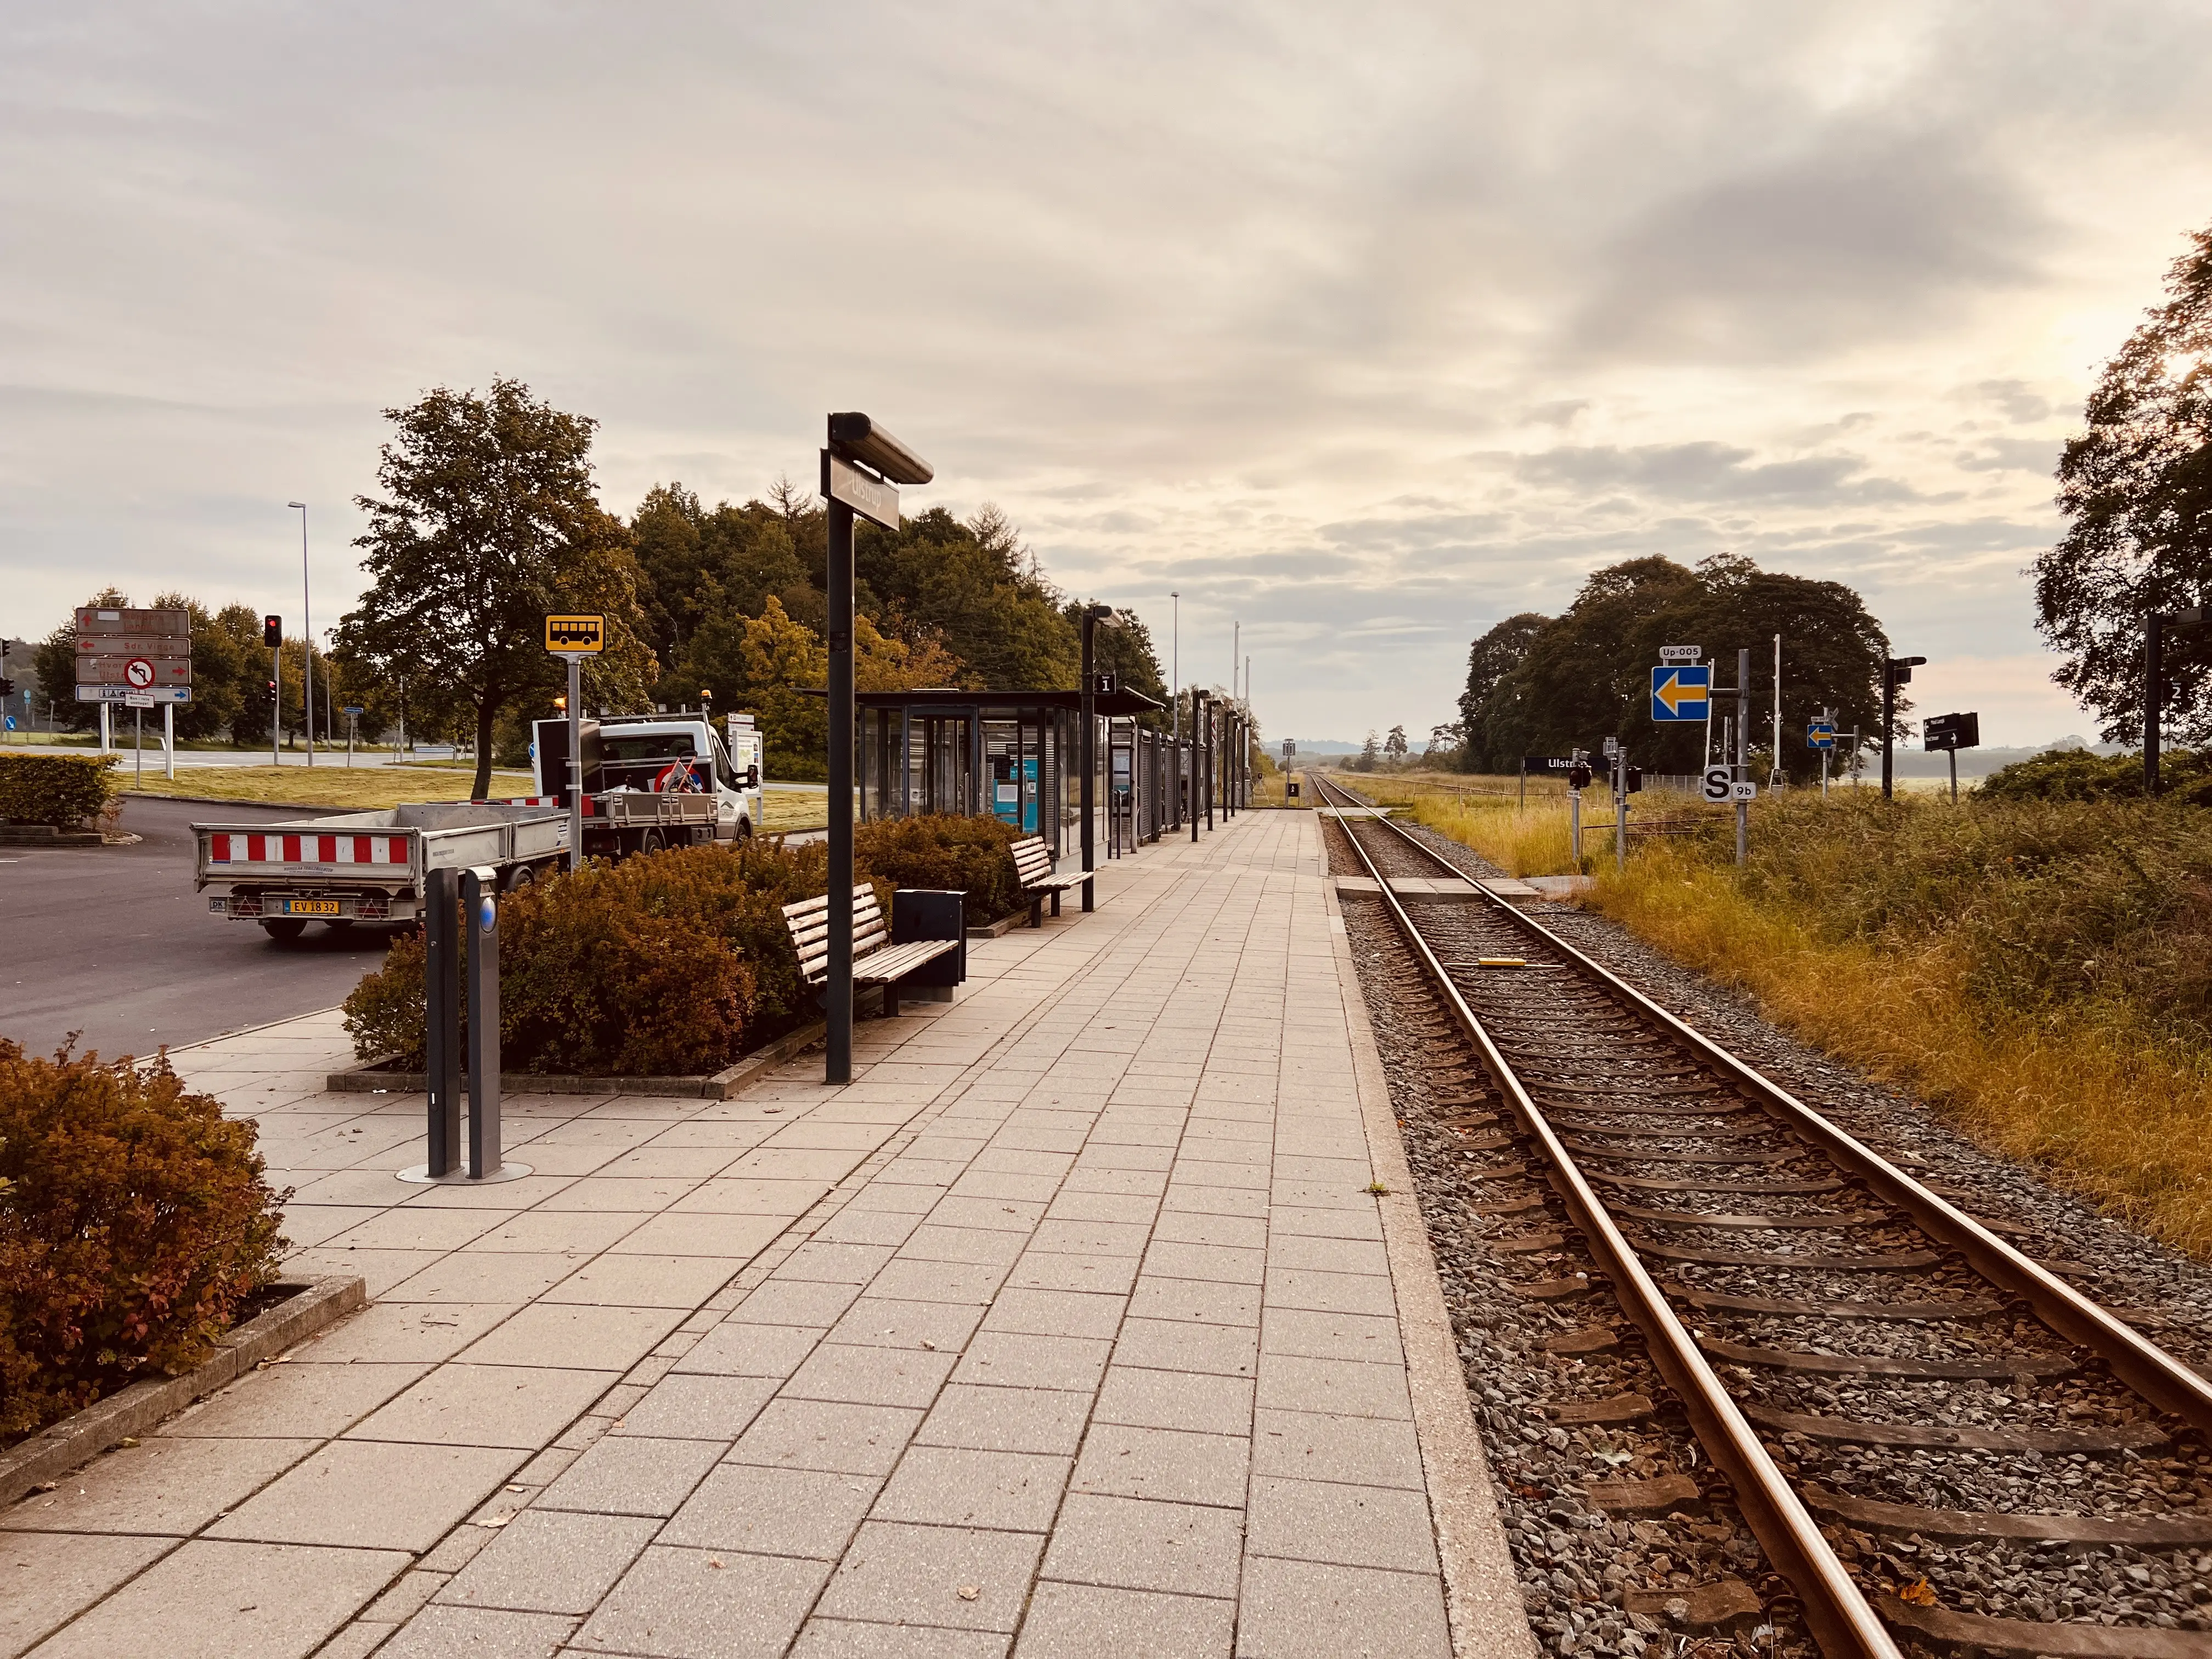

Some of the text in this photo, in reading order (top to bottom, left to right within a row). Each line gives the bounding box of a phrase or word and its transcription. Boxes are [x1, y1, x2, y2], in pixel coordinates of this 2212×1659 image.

[852, 470, 882, 512] Ulstrup
[147, 643, 174, 651] Vinge
[1103, 680, 1109, 691] 1
[2172, 687, 2181, 698] 2
[1706, 770, 1729, 798] S
[1737, 787, 1751, 795] 9b
[295, 902, 335, 912] EV 18 32
